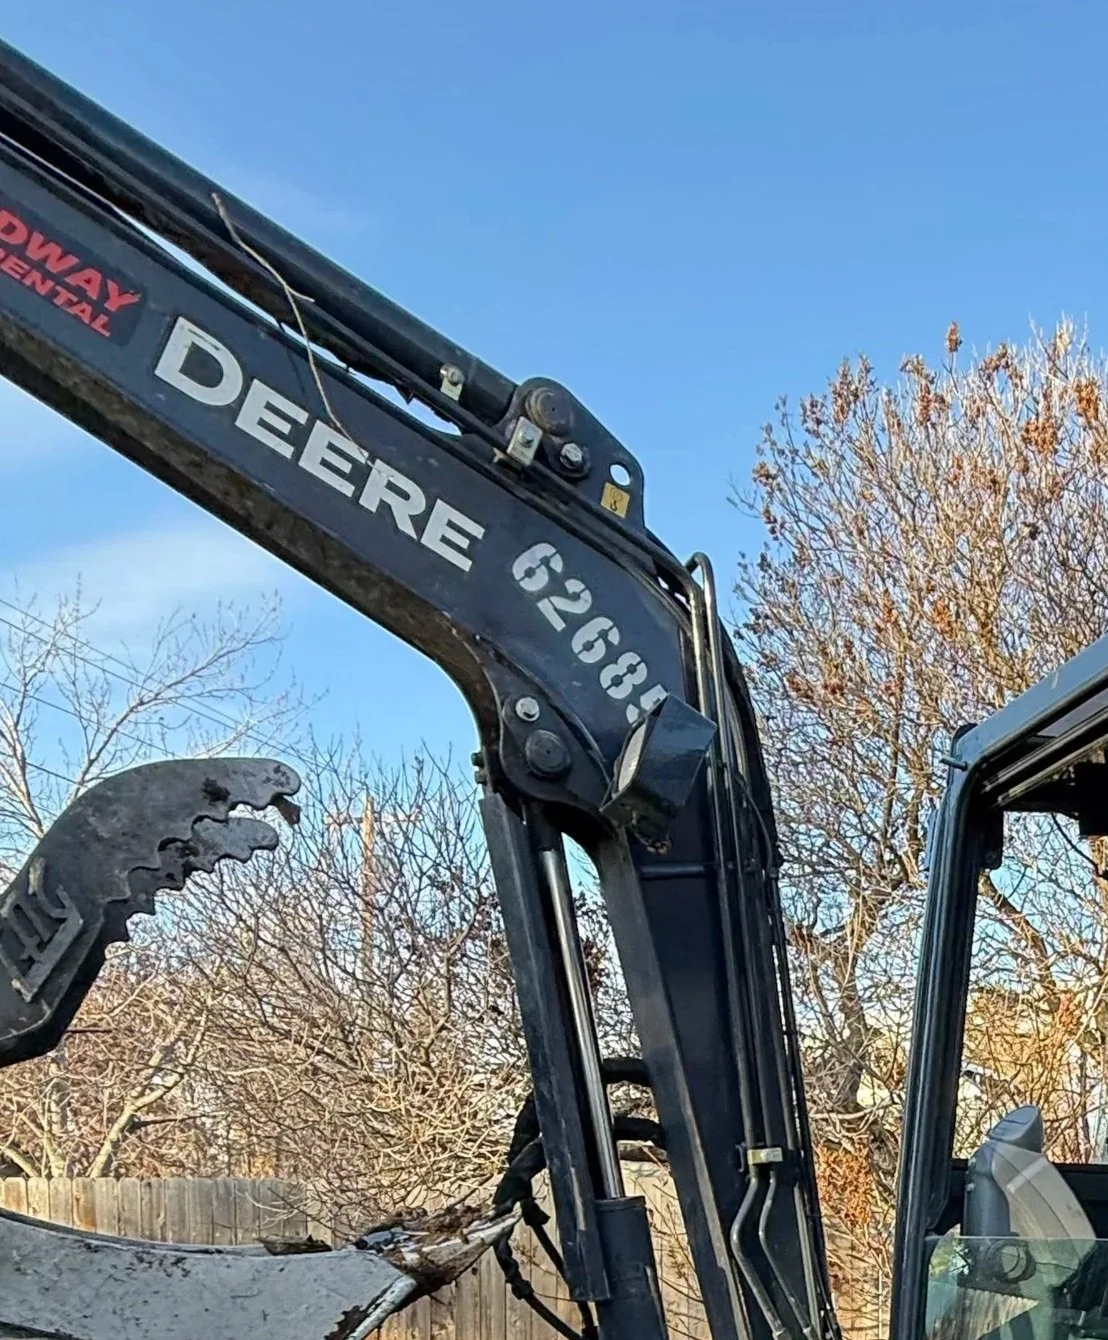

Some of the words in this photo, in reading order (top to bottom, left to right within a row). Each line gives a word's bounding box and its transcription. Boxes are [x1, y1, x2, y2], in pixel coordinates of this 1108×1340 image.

[0, 209, 140, 312] DWAY
[0, 247, 111, 337] ENTAL
[154, 316, 485, 572] DEERE
